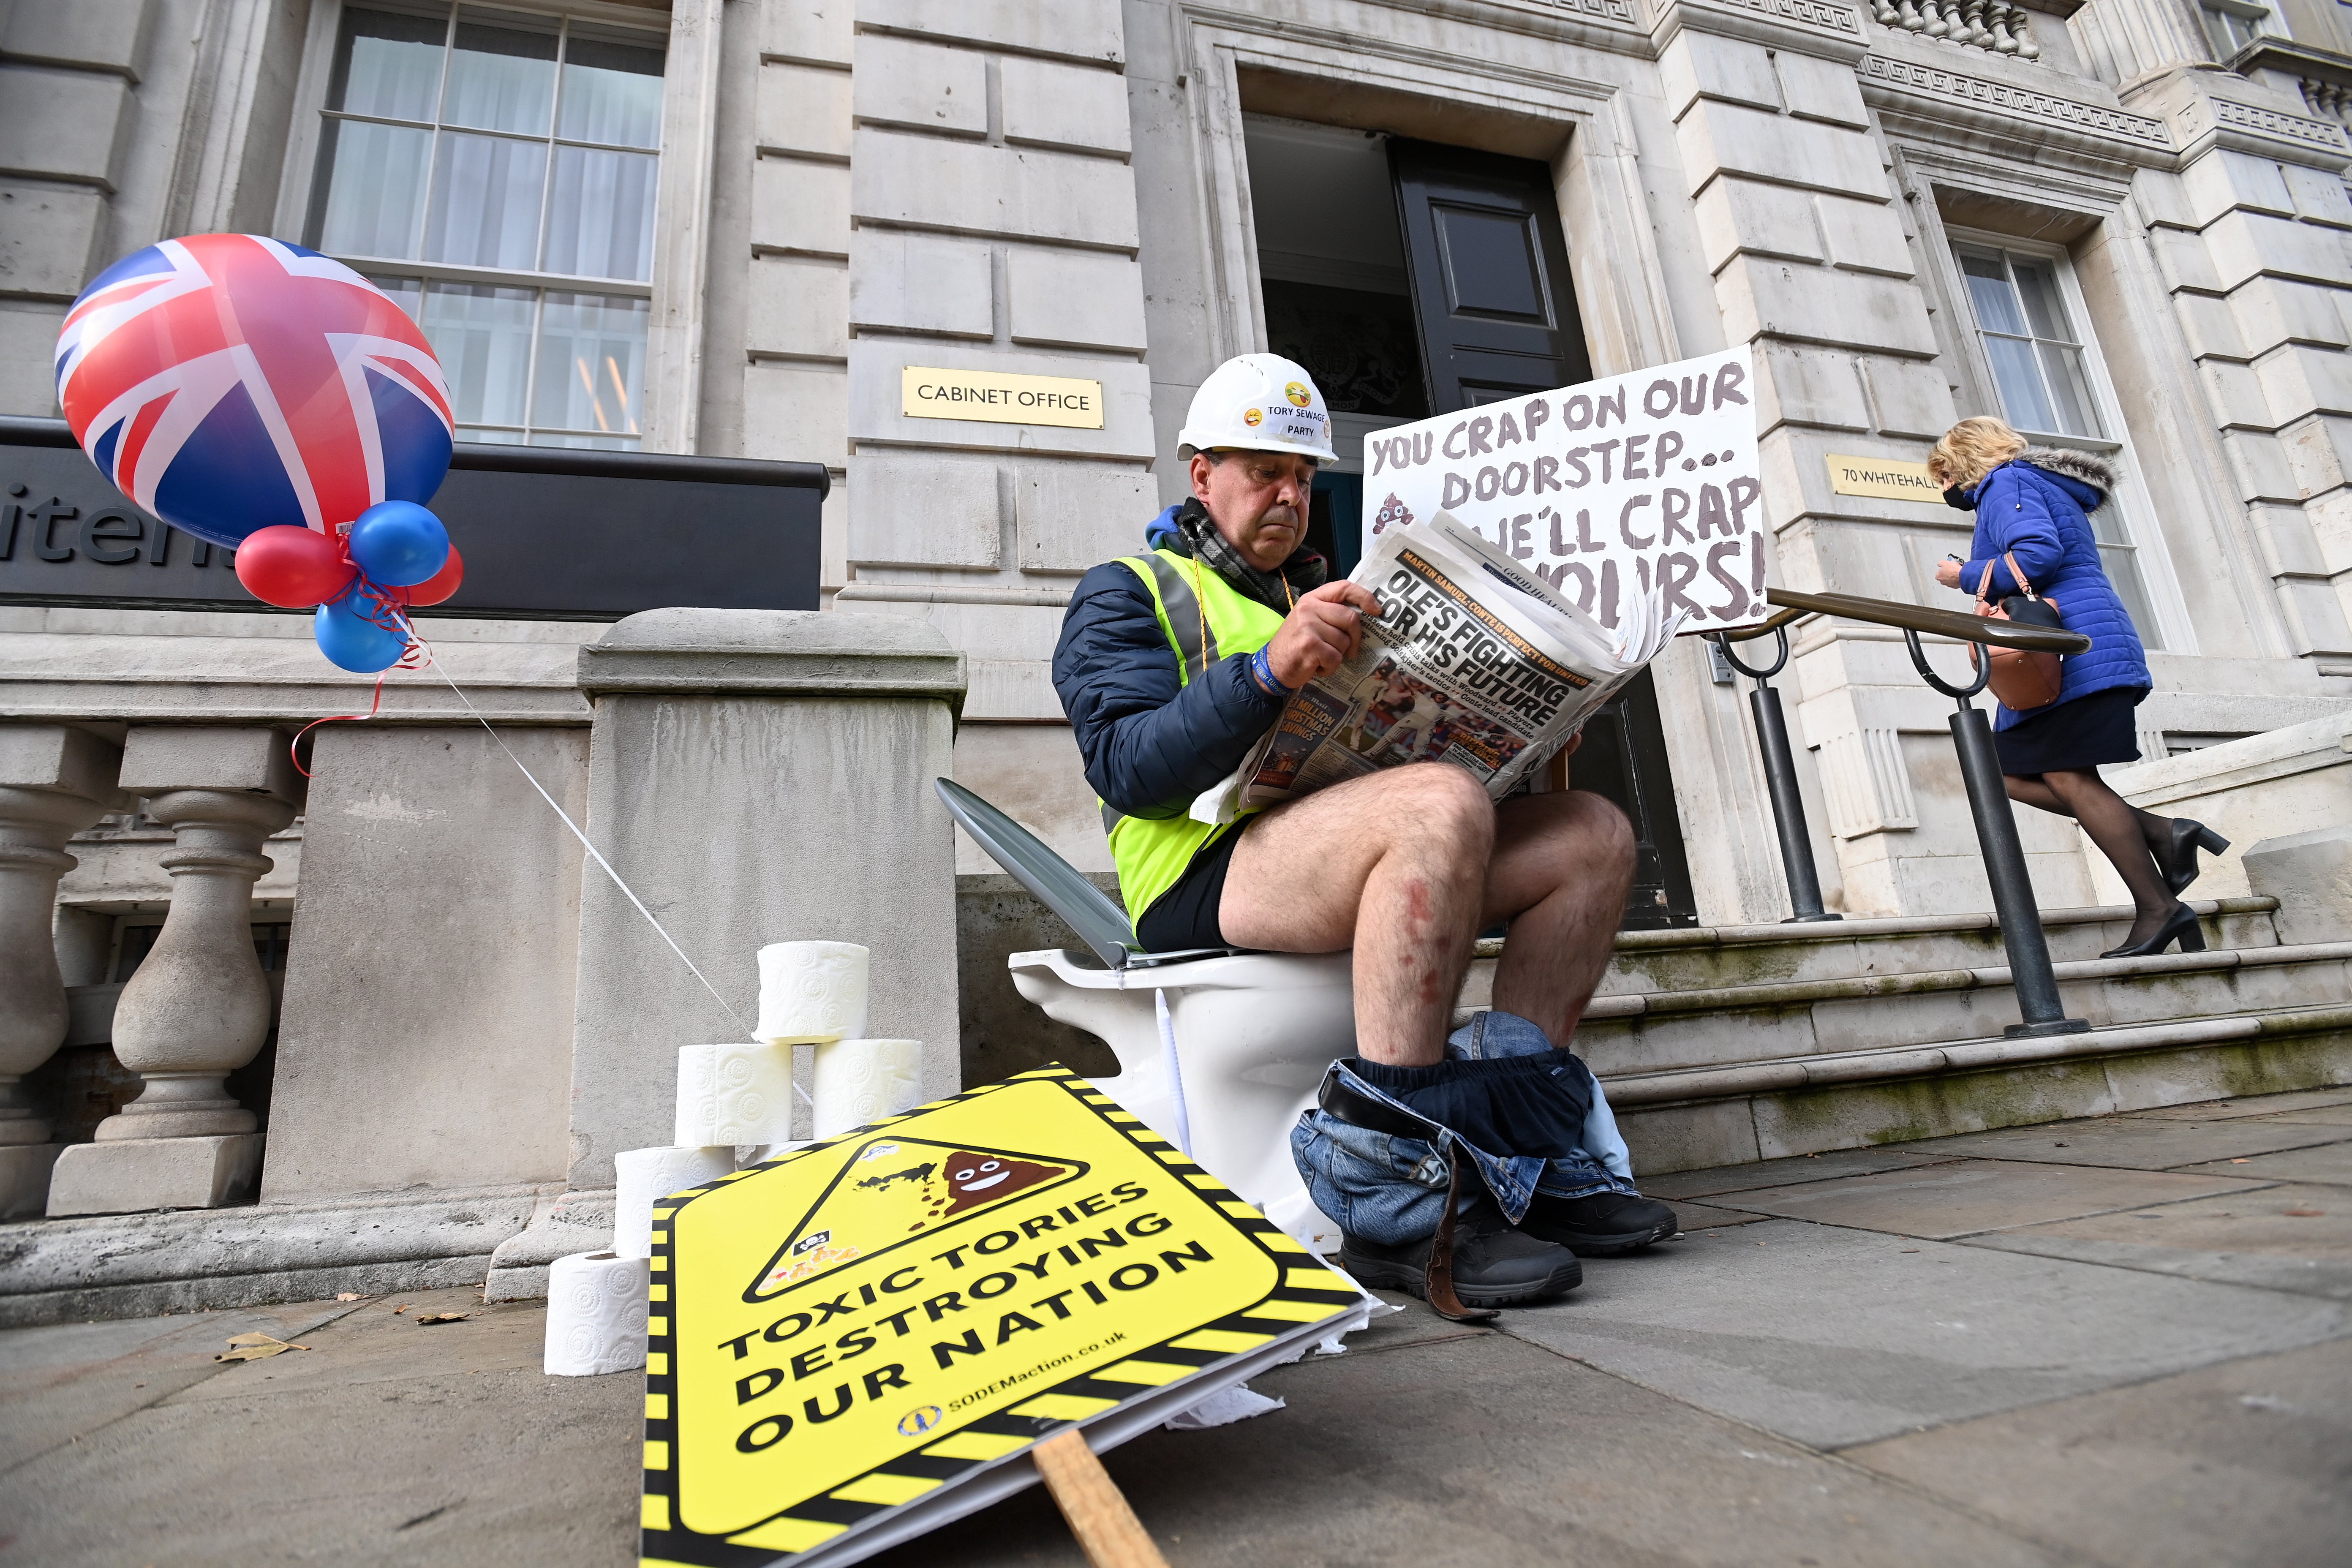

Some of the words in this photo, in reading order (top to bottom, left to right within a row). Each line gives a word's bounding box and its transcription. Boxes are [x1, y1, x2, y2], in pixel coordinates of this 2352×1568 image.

[918, 384, 1012, 405] CABINET
[1018, 392, 1089, 411] OFFICE
[1268, 406, 1293, 416] TORY
[1296, 408, 1325, 422] SEWAGE
[1372, 429, 1434, 476] YOU
[1442, 398, 1550, 460] CRAP
[1562, 383, 1627, 432] ON
[1643, 362, 1749, 420] OUR
[1288, 425, 1314, 437] PARTY
[1842, 468, 1858, 482] 70
[1859, 470, 1939, 490] WHITEHALL
[1619, 476, 1761, 551] CRAP
[1403, 551, 1438, 579] MARTIN
[1435, 575, 1470, 604] SAMUEL:
[1470, 602, 1497, 626] CONTE
[1494, 622, 1505, 633] IS
[1503, 629, 1541, 660] PERFECT
[1538, 656, 1557, 671] FOR
[1555, 667, 1588, 685] UNITED
[1504, 568, 1532, 589] GOOD
[1531, 587, 1573, 618] HEALT
[1372, 587, 1418, 636] FOR
[1413, 622, 1459, 668] HIS
[1452, 657, 1559, 727] FUTURE
[1387, 569, 1459, 631] OLE'S
[1451, 619, 1570, 707] FIGHTING
[1256, 664, 1268, 680] Forever
[1360, 619, 1392, 645] estioning
[1391, 642, 1425, 676] Solskjaer's
[1426, 672, 1451, 690] tactics
[1461, 693, 1482, 708] Conte
[1482, 705, 1500, 717] lead
[1499, 715, 1534, 739] candidate
[1362, 610, 1387, 632] Glazers
[1387, 629, 1406, 643] hold
[1405, 641, 1421, 660] crisis
[1421, 656, 1440, 674] talks
[1440, 672, 1457, 685] with
[1459, 682, 1499, 707] Woodward
[1506, 709, 1535, 730] Players
[1280, 721, 1317, 741] SAVINGS
[1298, 700, 1335, 727] MILLION
[1447, 733, 1475, 751] BEN'S
[1474, 747, 1502, 768] BACK!
[1453, 744, 1470, 757] ENGLAND
[1469, 755, 1479, 764] STAR
[1478, 762, 1492, 773] STOKES
[1457, 751, 1466, 760] JOIN
[1465, 757, 1477, 766] ASHES
[1476, 765, 1489, 774] PARTY
[1460, 732, 1500, 757] BUZZING
[717, 1266, 926, 1362] TOXIC
[931, 1181, 1150, 1270] TORIES
[735, 1211, 1175, 1407] DESTROYING
[735, 1362, 912, 1455] OUR
[932, 1240, 1214, 1372] NATION
[949, 1332, 1128, 1413] SODEMaction.co.uk
